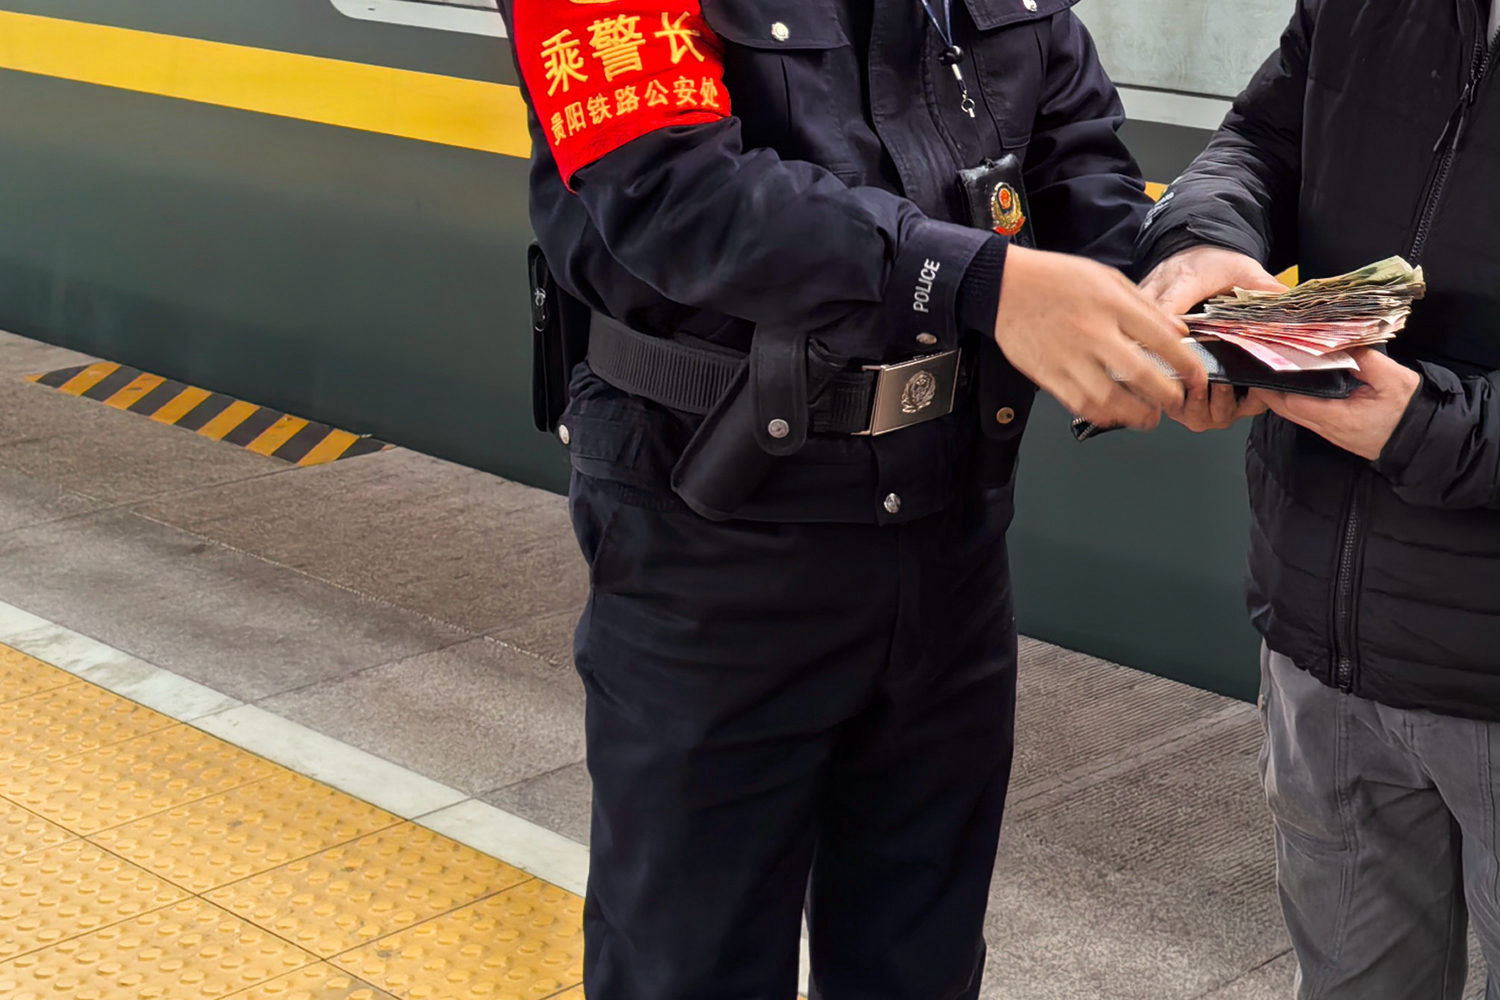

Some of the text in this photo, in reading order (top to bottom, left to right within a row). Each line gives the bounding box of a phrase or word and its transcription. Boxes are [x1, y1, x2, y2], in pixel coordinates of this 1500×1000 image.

[540, 10, 705, 97] 乘警长
[550, 75, 720, 147] 贵阳铁路公安处
[912, 258, 941, 314] POLICE
